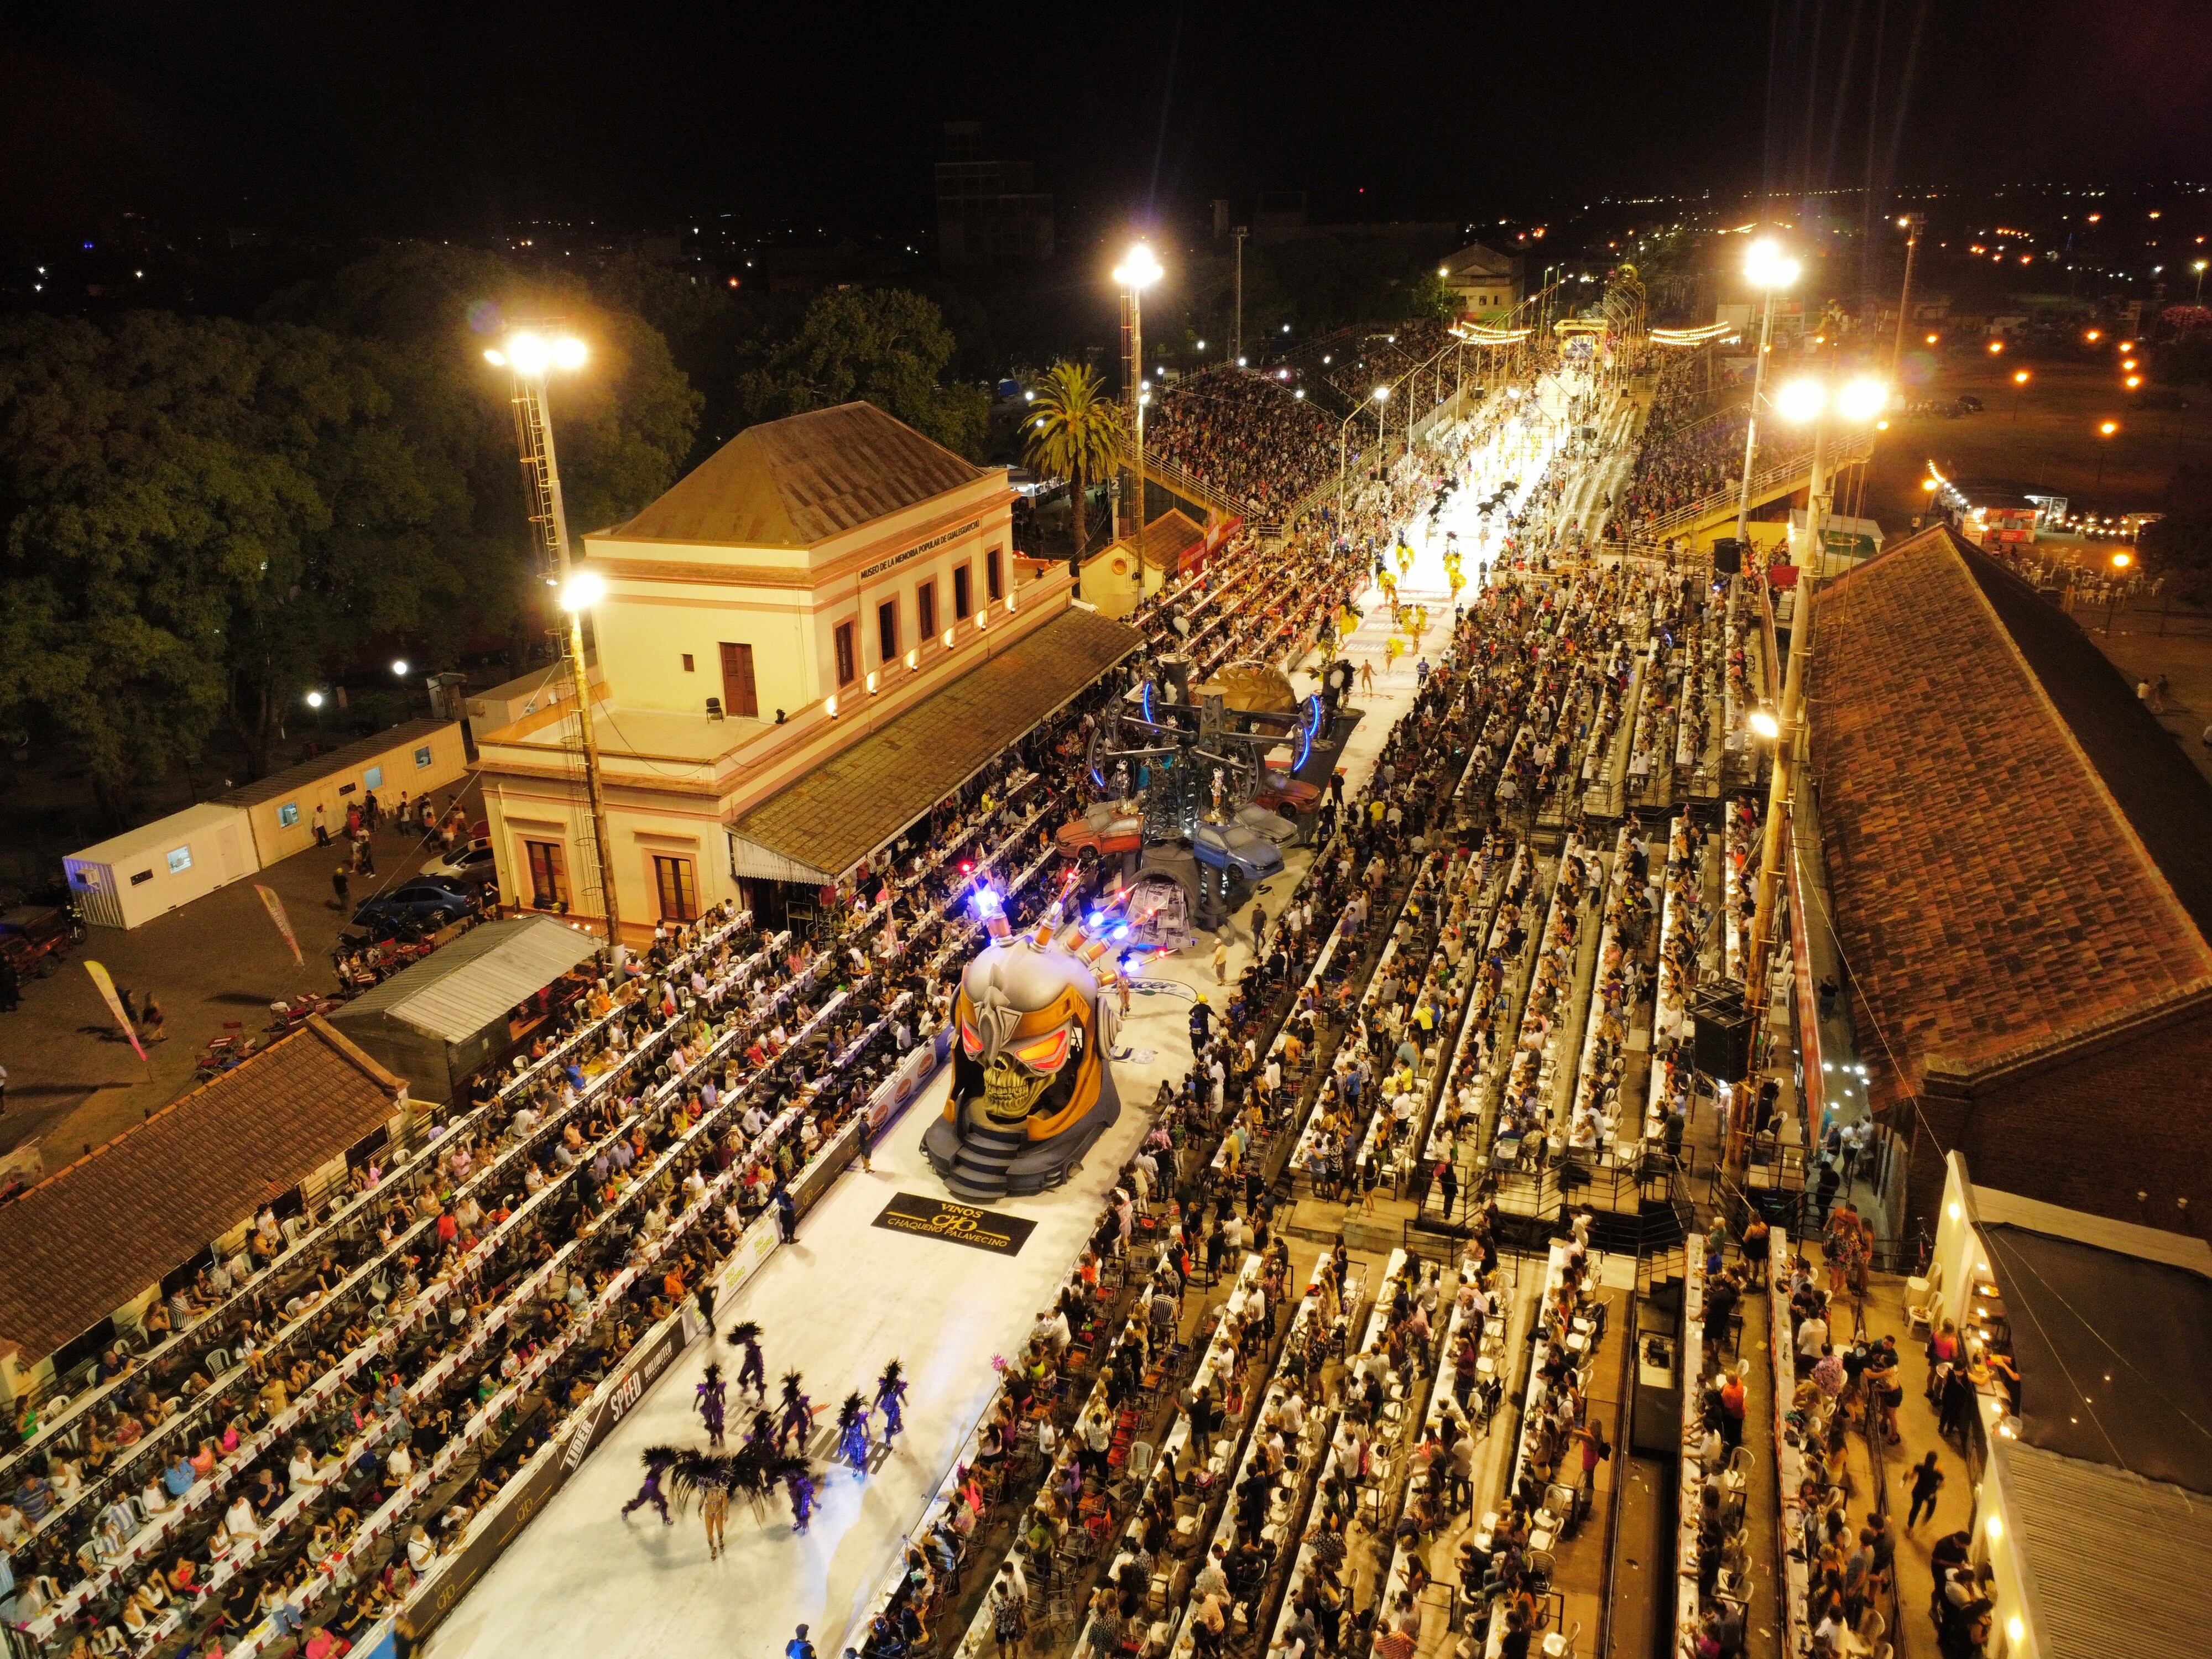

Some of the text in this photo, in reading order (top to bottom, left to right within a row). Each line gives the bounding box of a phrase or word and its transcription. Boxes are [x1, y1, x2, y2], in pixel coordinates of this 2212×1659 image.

[1111, 479, 1119, 490] 2
[861, 565, 879, 580] MUSEO
[880, 561, 887, 571] DE
[888, 559, 894, 568] LA
[895, 548, 918, 565] MEMORIA
[919, 539, 940, 555] POPULAR
[941, 535, 947, 544] DE
[941, 1203, 984, 1218] VINOS
[944, 1229, 1008, 1247] PALAVECINO
[644, 1341, 672, 1378] UNLIMITED
[566, 1371, 641, 1468] LIDER SPEED
